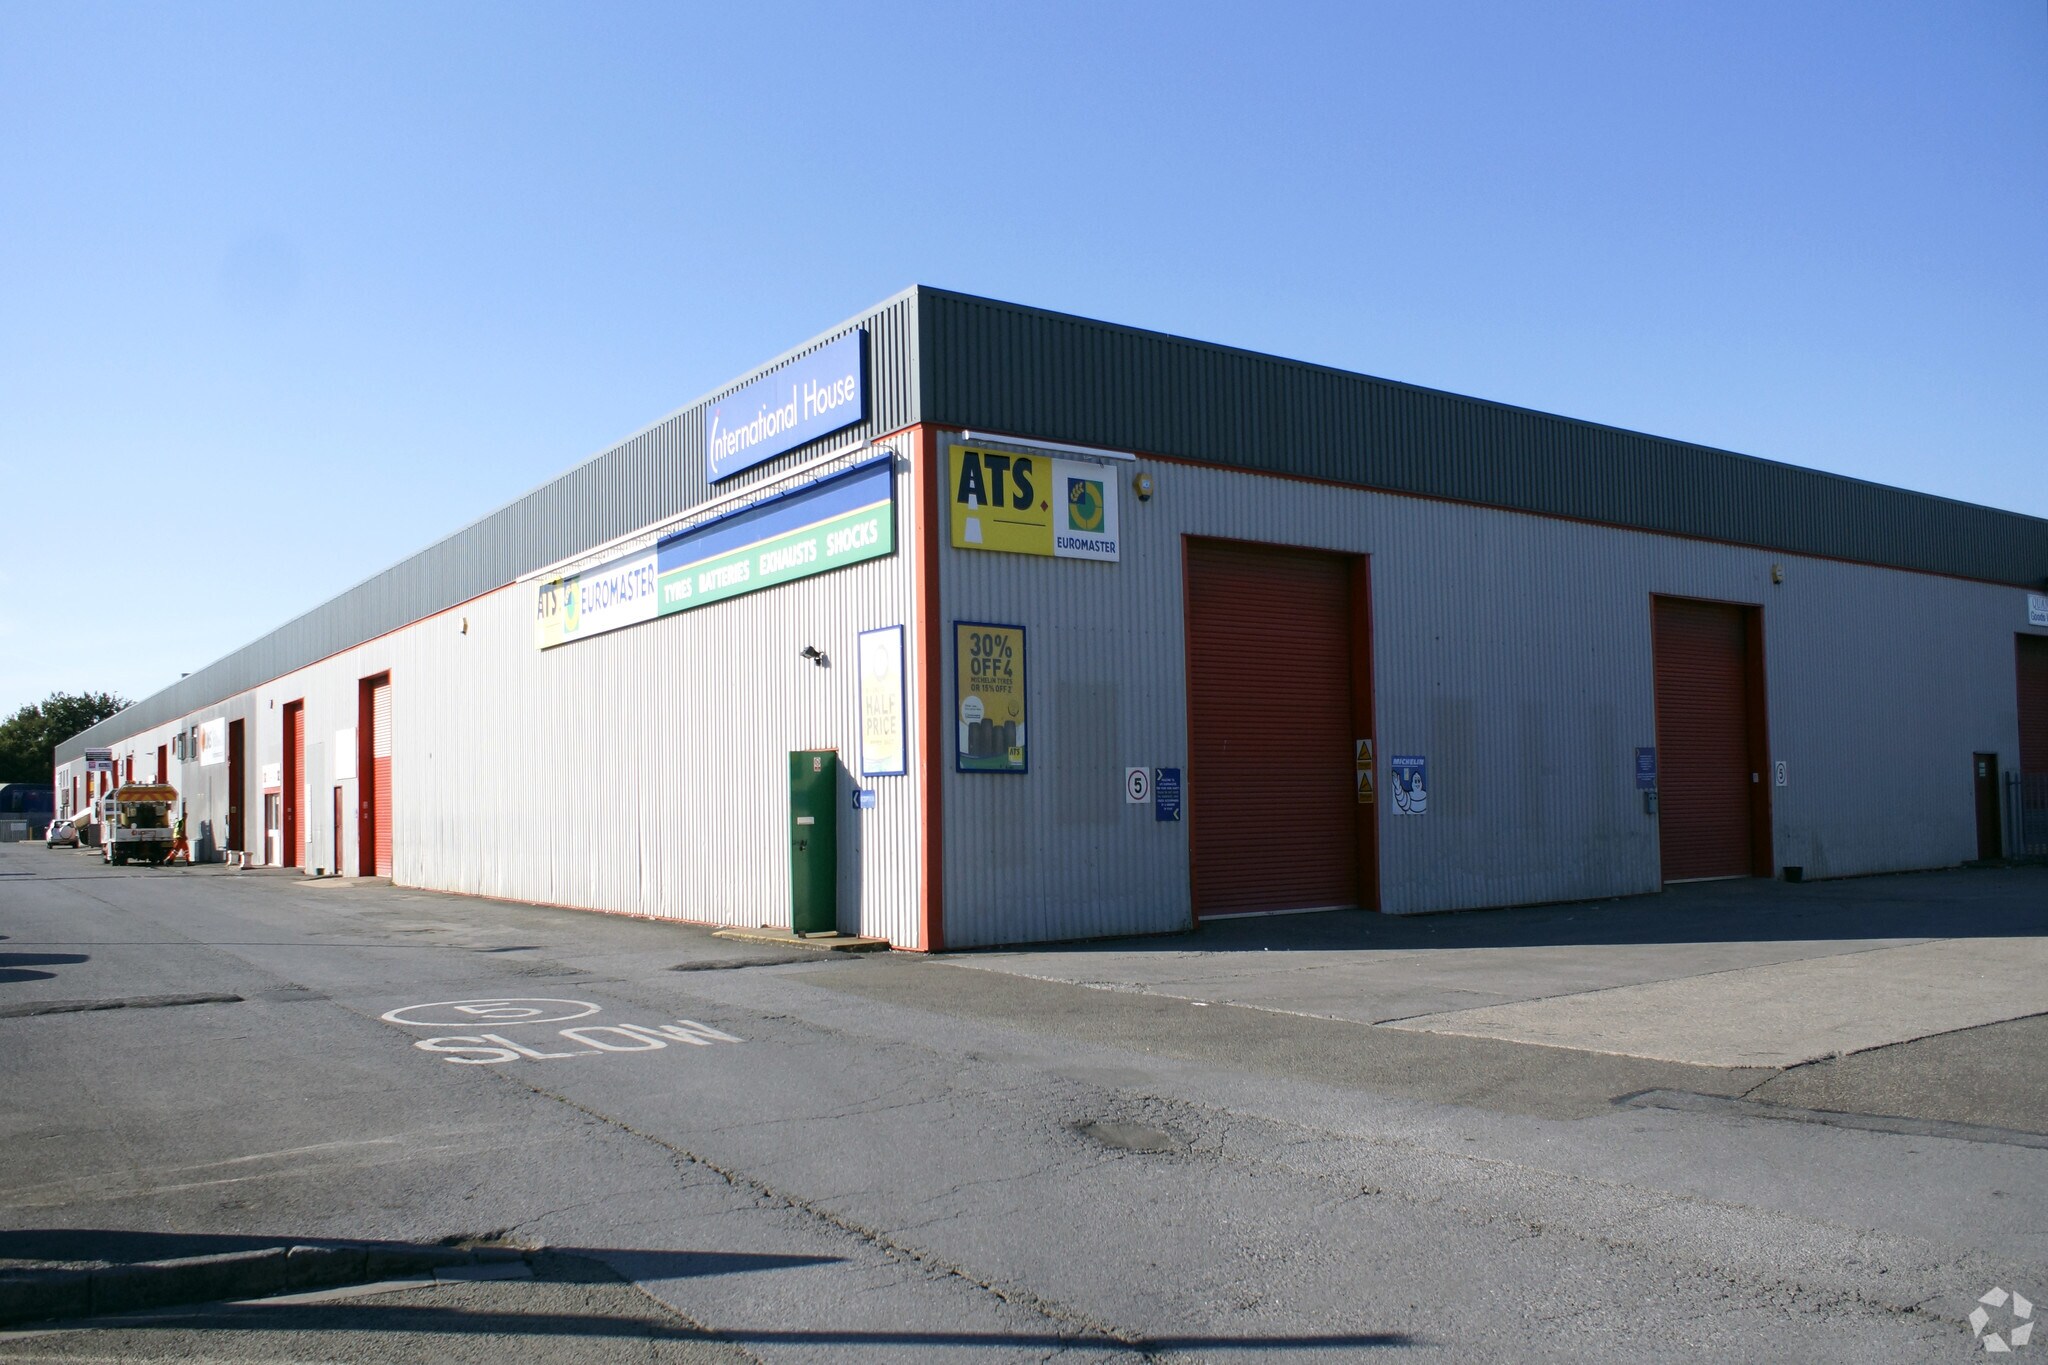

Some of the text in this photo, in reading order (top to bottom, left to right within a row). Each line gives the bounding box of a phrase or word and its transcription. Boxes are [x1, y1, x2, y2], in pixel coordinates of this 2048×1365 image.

[710, 374, 855, 474] International House
[956, 450, 1035, 511] ATS
[1057, 536, 1116, 554] EUROMASTER
[664, 520, 878, 604] TYRES BATTERIES EXHAUSTS SHOCKS
[581, 563, 655, 615] EUROMASTER
[970, 633, 1013, 658] 30%
[970, 658, 1013, 678] OFF 4
[970, 676, 997, 685] MICHELIN
[970, 684, 980, 692] OR
[982, 685, 995, 693] 15%
[866, 693, 895, 716] HALF
[866, 715, 897, 737] PRICE
[1392, 758, 1424, 766] MICHELIN
[1779, 769, 1783, 779] 5
[1134, 777, 1142, 794] 5
[454, 1002, 543, 1018] 5
[414, 1020, 747, 1064] SLOW
